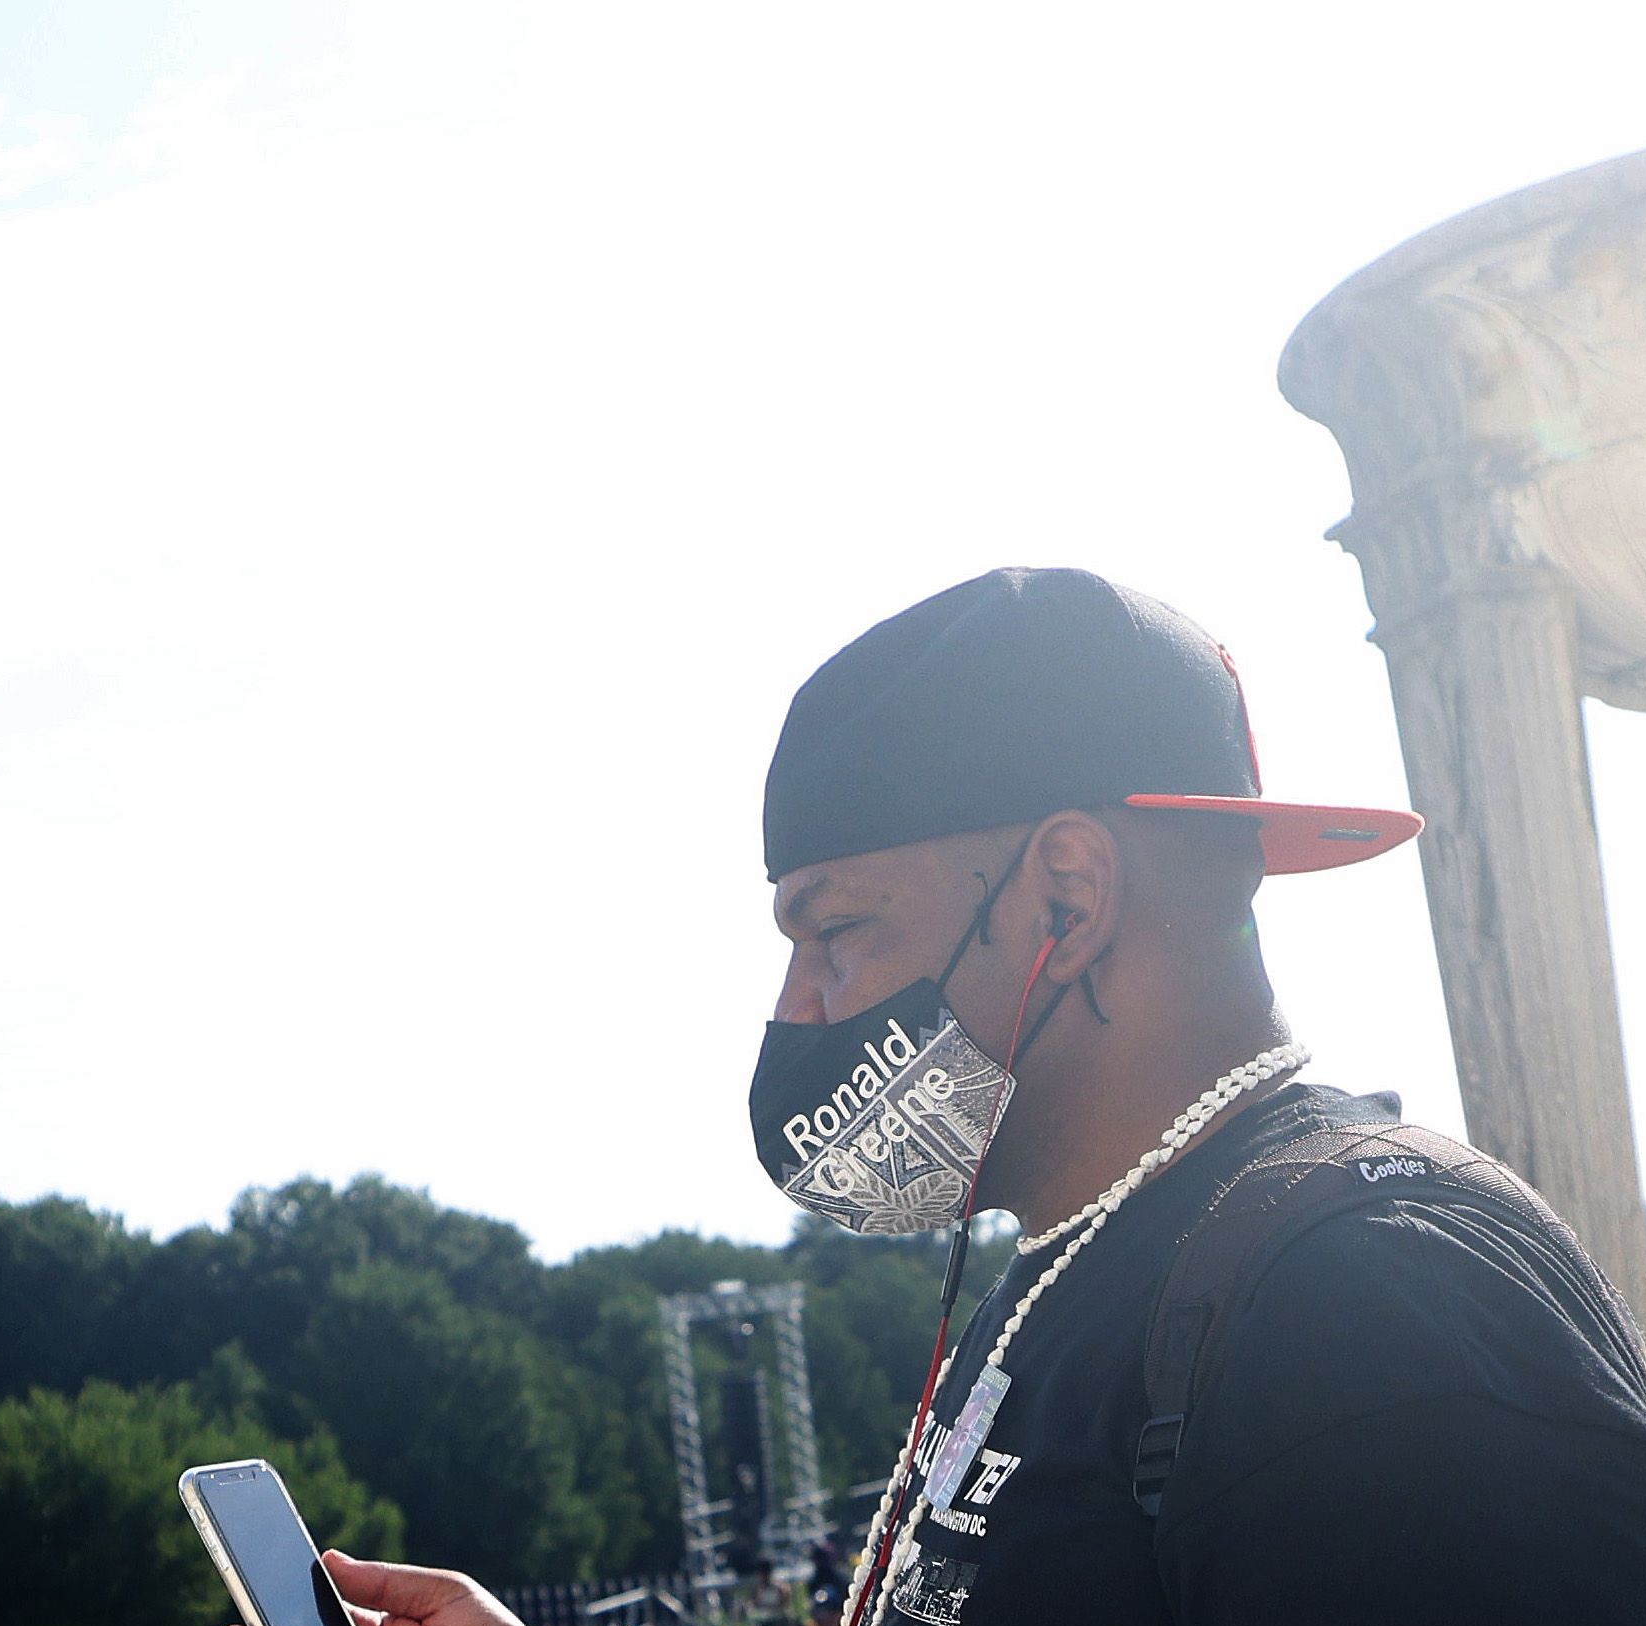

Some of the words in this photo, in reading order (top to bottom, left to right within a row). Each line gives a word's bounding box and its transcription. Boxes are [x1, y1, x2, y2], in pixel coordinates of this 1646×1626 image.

[783, 1018, 917, 1161] Ronald
[813, 1067, 955, 1197] Greene
[1358, 1156, 1426, 1184] Cookies
[963, 1448, 1022, 1505] TER
[968, 1514, 987, 1537] DC
